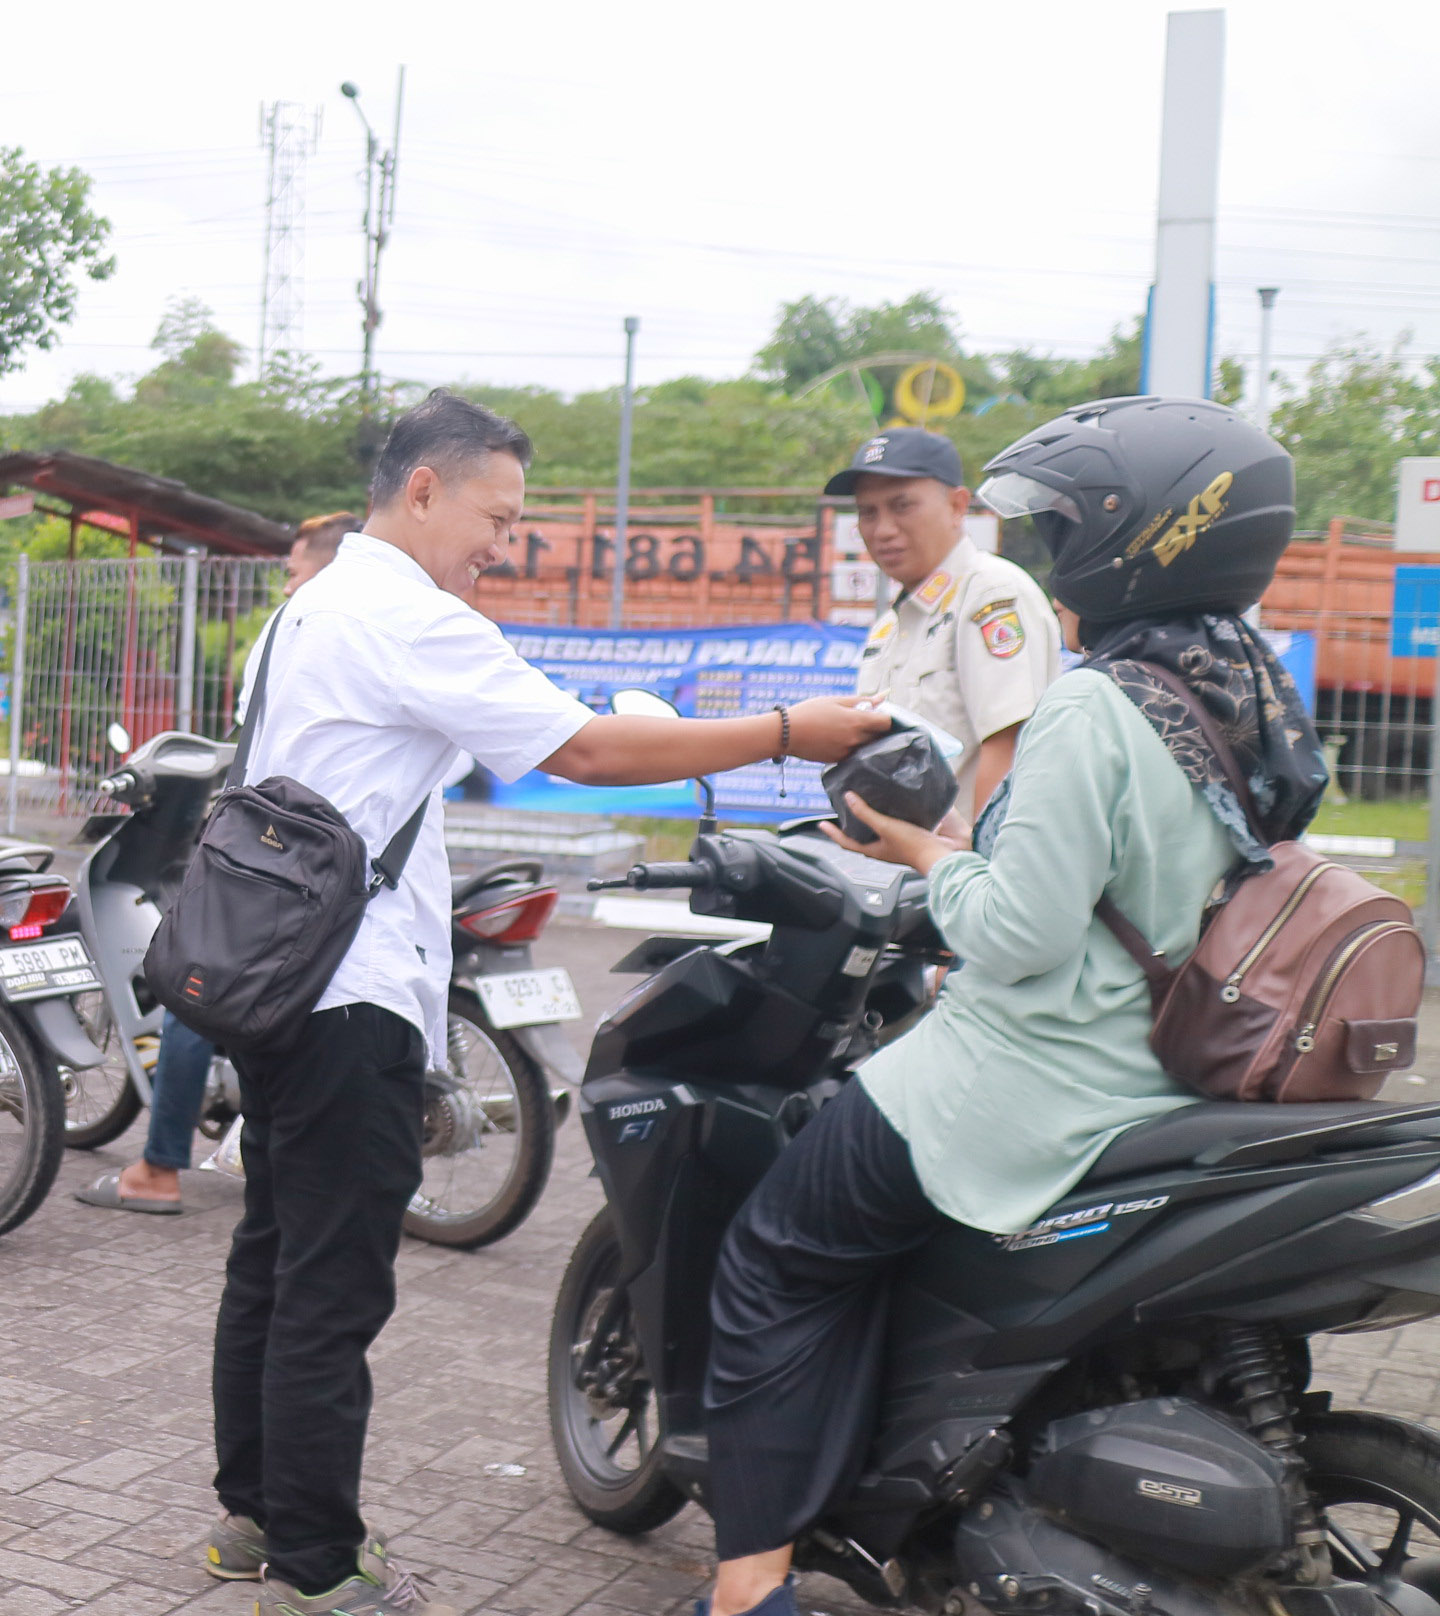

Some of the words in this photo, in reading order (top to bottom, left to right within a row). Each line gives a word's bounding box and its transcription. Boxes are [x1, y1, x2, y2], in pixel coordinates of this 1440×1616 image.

[696, 639, 822, 667] PAJAK
[12, 950, 54, 974] 5981
[60, 946, 85, 967] PM
[610, 1098, 667, 1120] HONDA
[618, 1120, 654, 1143] FI
[1038, 1203, 1113, 1230] RIO
[1112, 1195, 1171, 1216] 150
